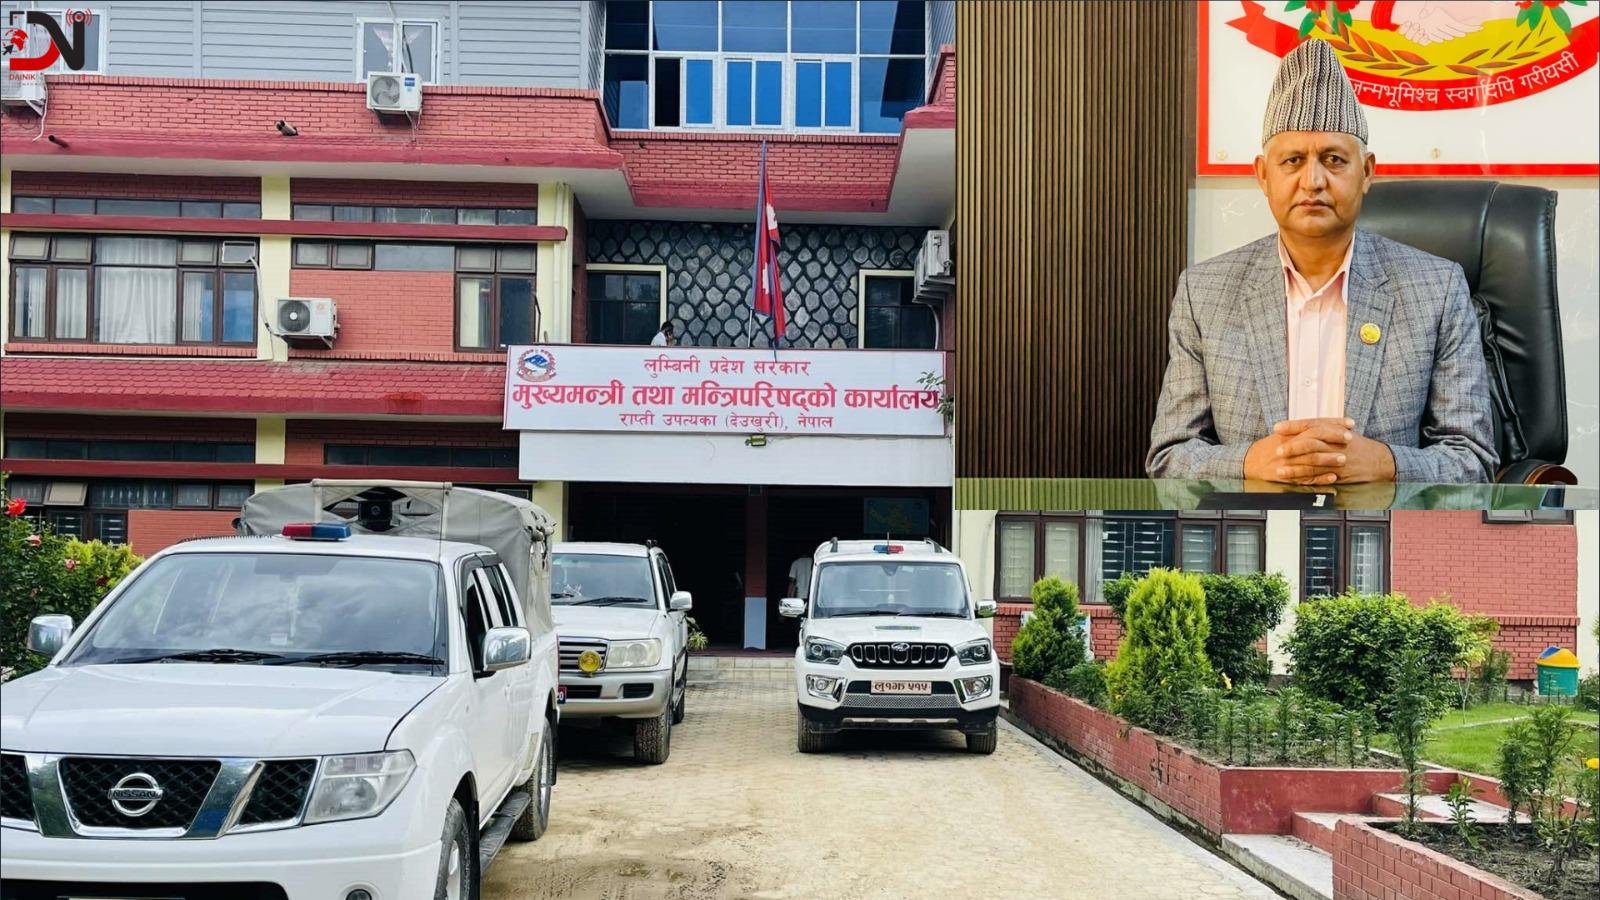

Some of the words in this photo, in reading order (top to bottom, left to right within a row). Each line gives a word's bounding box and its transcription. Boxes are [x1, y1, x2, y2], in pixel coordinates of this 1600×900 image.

[1520, 51, 1580, 90] गरीयसी
[644, 354, 700, 378] लुम्बिनी
[710, 356, 745, 374] प्रदेश
[754, 360, 811, 376] सरकार
[512, 380, 625, 409] मुख्यमन्त्री
[632, 386, 675, 406] तथा
[682, 380, 837, 411] मन्त्रिपरिषद्को
[844, 385, 940, 410] कार्यालय
[619, 410, 655, 427] राप्ती
[662, 414, 717, 427] उपत्यका
[798, 413, 834, 428] नेपाल
